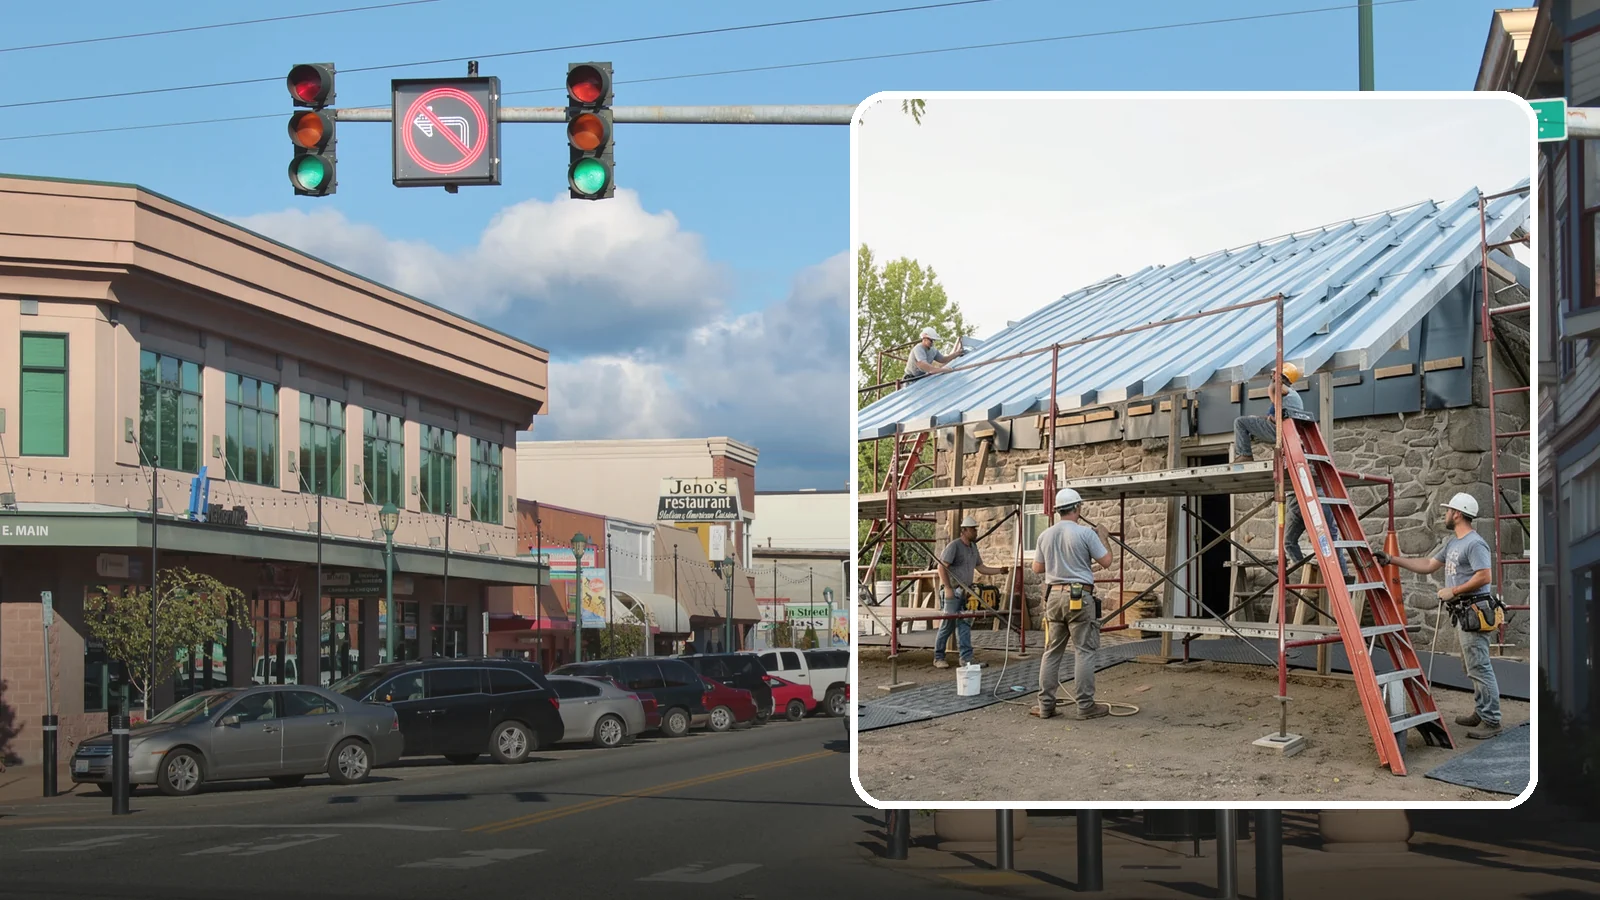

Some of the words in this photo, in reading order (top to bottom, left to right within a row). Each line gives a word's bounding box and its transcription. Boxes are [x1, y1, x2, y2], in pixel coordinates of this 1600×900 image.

[670, 480, 728, 494] Jeno's
[665, 496, 731, 509] restaurant
[659, 510, 682, 519] Italian
[686, 509, 714, 519] American
[715, 509, 737, 519] Cuisine
[2, 525, 13, 536] E.
[15, 525, 49, 536] MAIN
[786, 607, 795, 617] in
[797, 607, 829, 617] Street
[791, 619, 824, 627] lass
